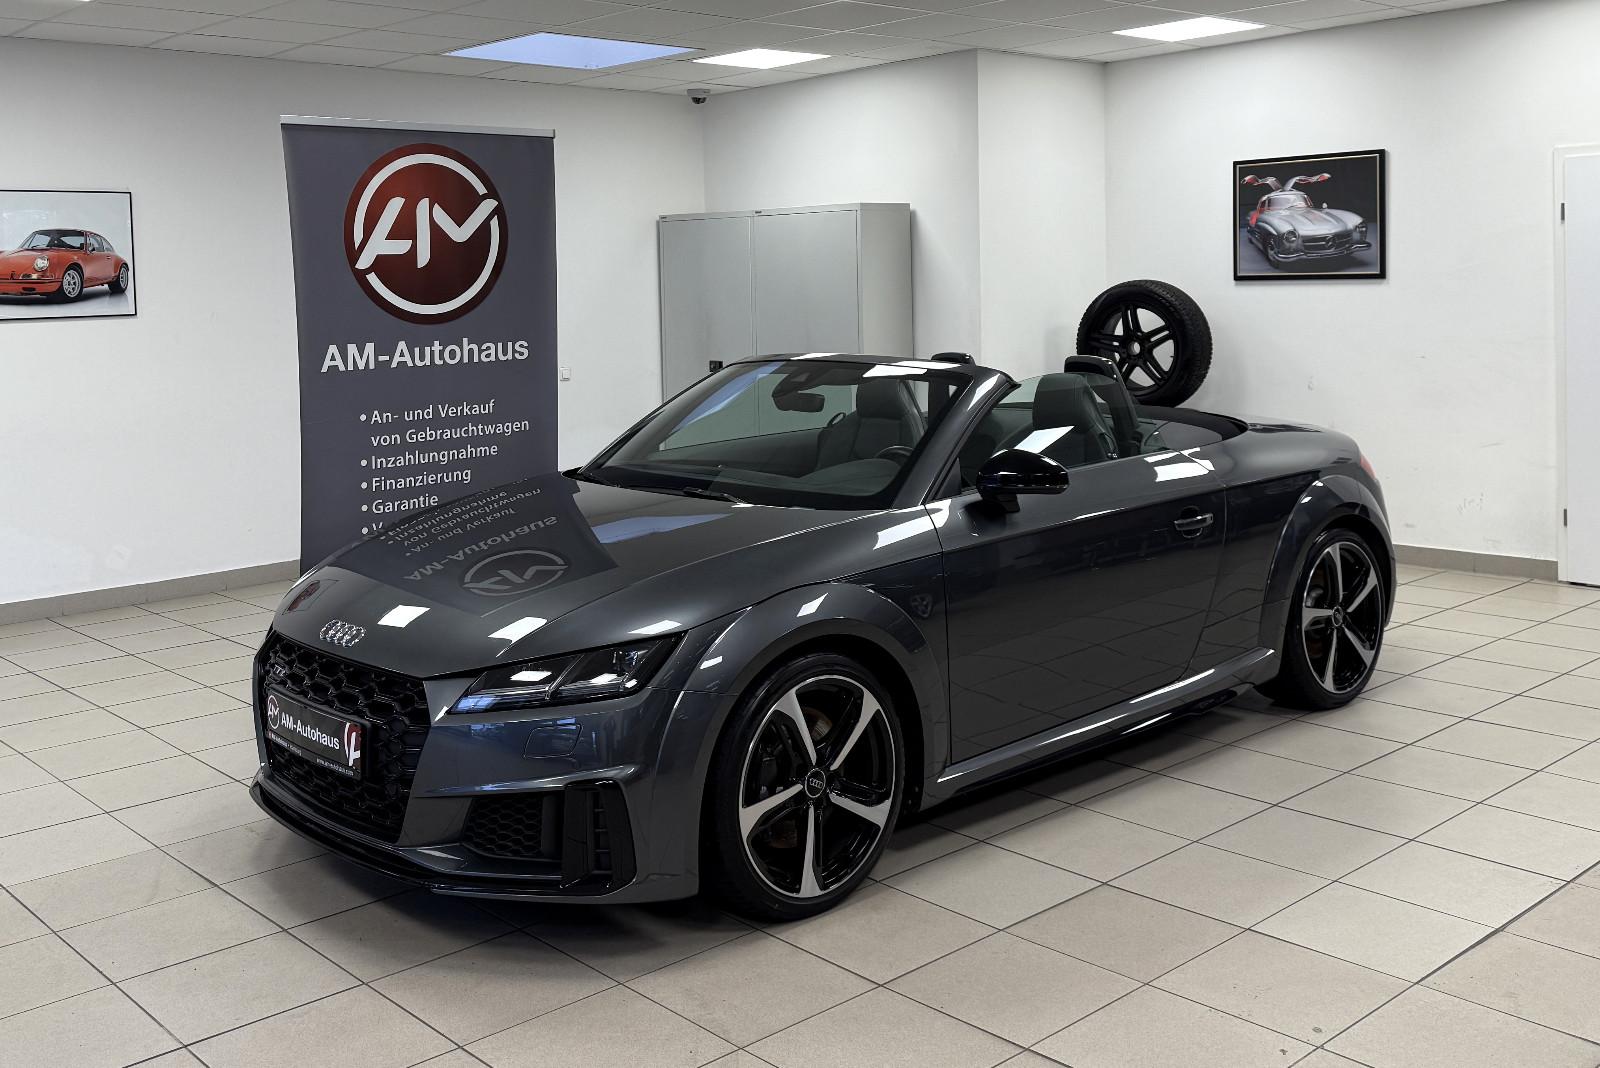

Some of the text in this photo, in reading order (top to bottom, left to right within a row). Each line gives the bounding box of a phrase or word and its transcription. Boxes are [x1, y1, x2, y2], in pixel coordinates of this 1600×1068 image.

[320, 337, 530, 373] AM-Autohaus
[370, 399, 496, 425] An- und Verkauf
[370, 419, 530, 447] von Gebrauchtwagen
[371, 444, 498, 470] Inzahlungnahme
[372, 468, 472, 492] Finanzierung
[372, 493, 439, 514] Garantie
[281, 711, 340, 750] AM-Autohaus
